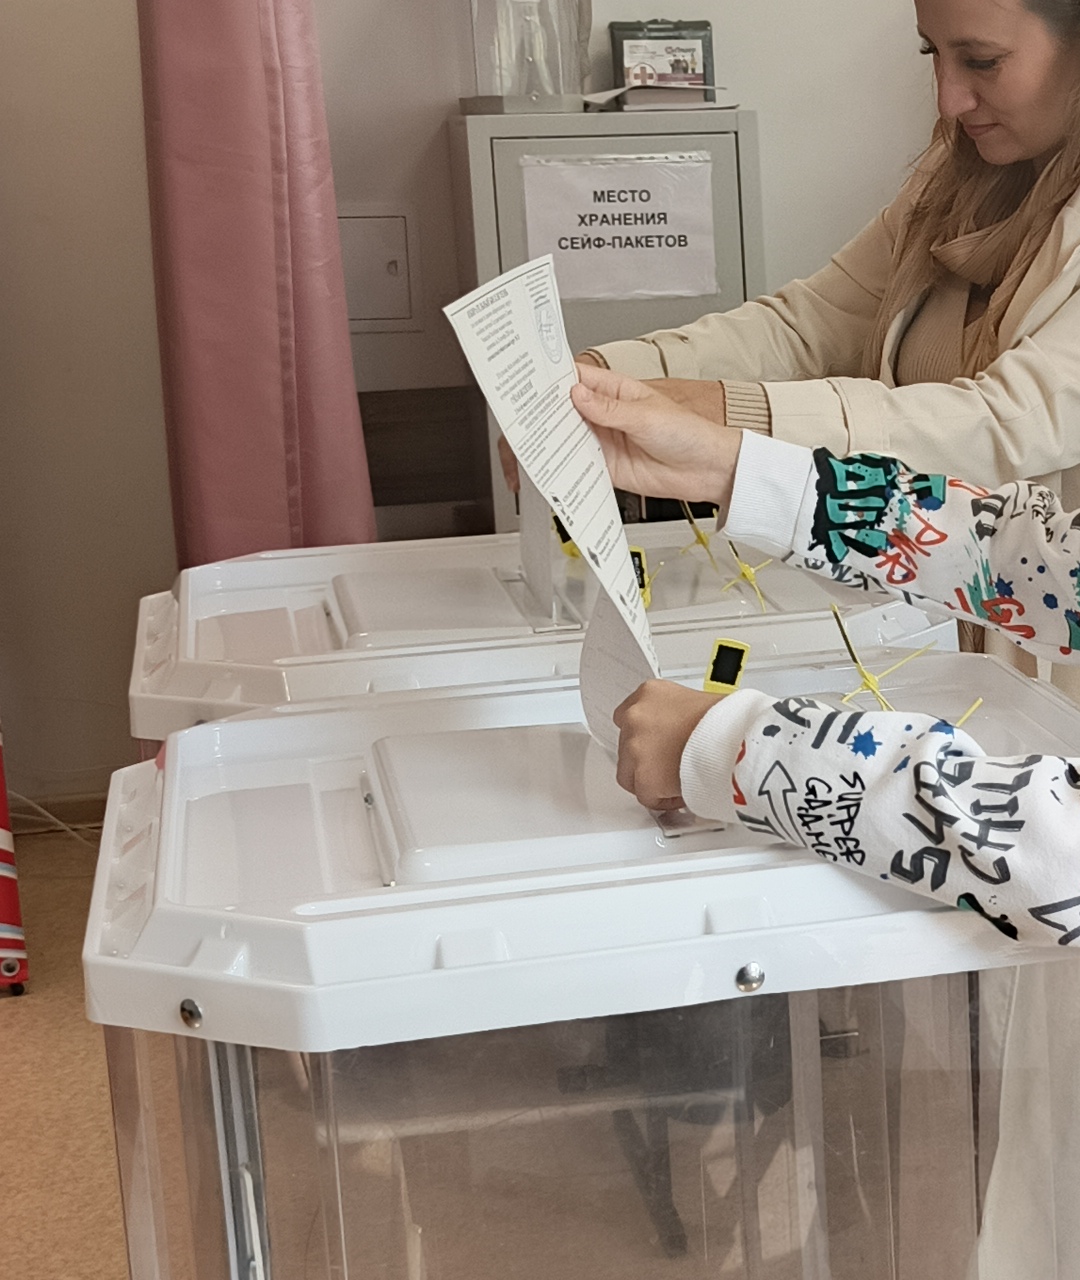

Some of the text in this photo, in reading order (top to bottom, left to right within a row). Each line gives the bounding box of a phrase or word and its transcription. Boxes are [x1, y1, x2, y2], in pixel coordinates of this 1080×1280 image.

[592, 189, 652, 204] МЕСТО
[577, 212, 668, 227] ХРАНЕНИЯ
[557, 233, 689, 250] СЕЙФ-ПАКЕТОВ
